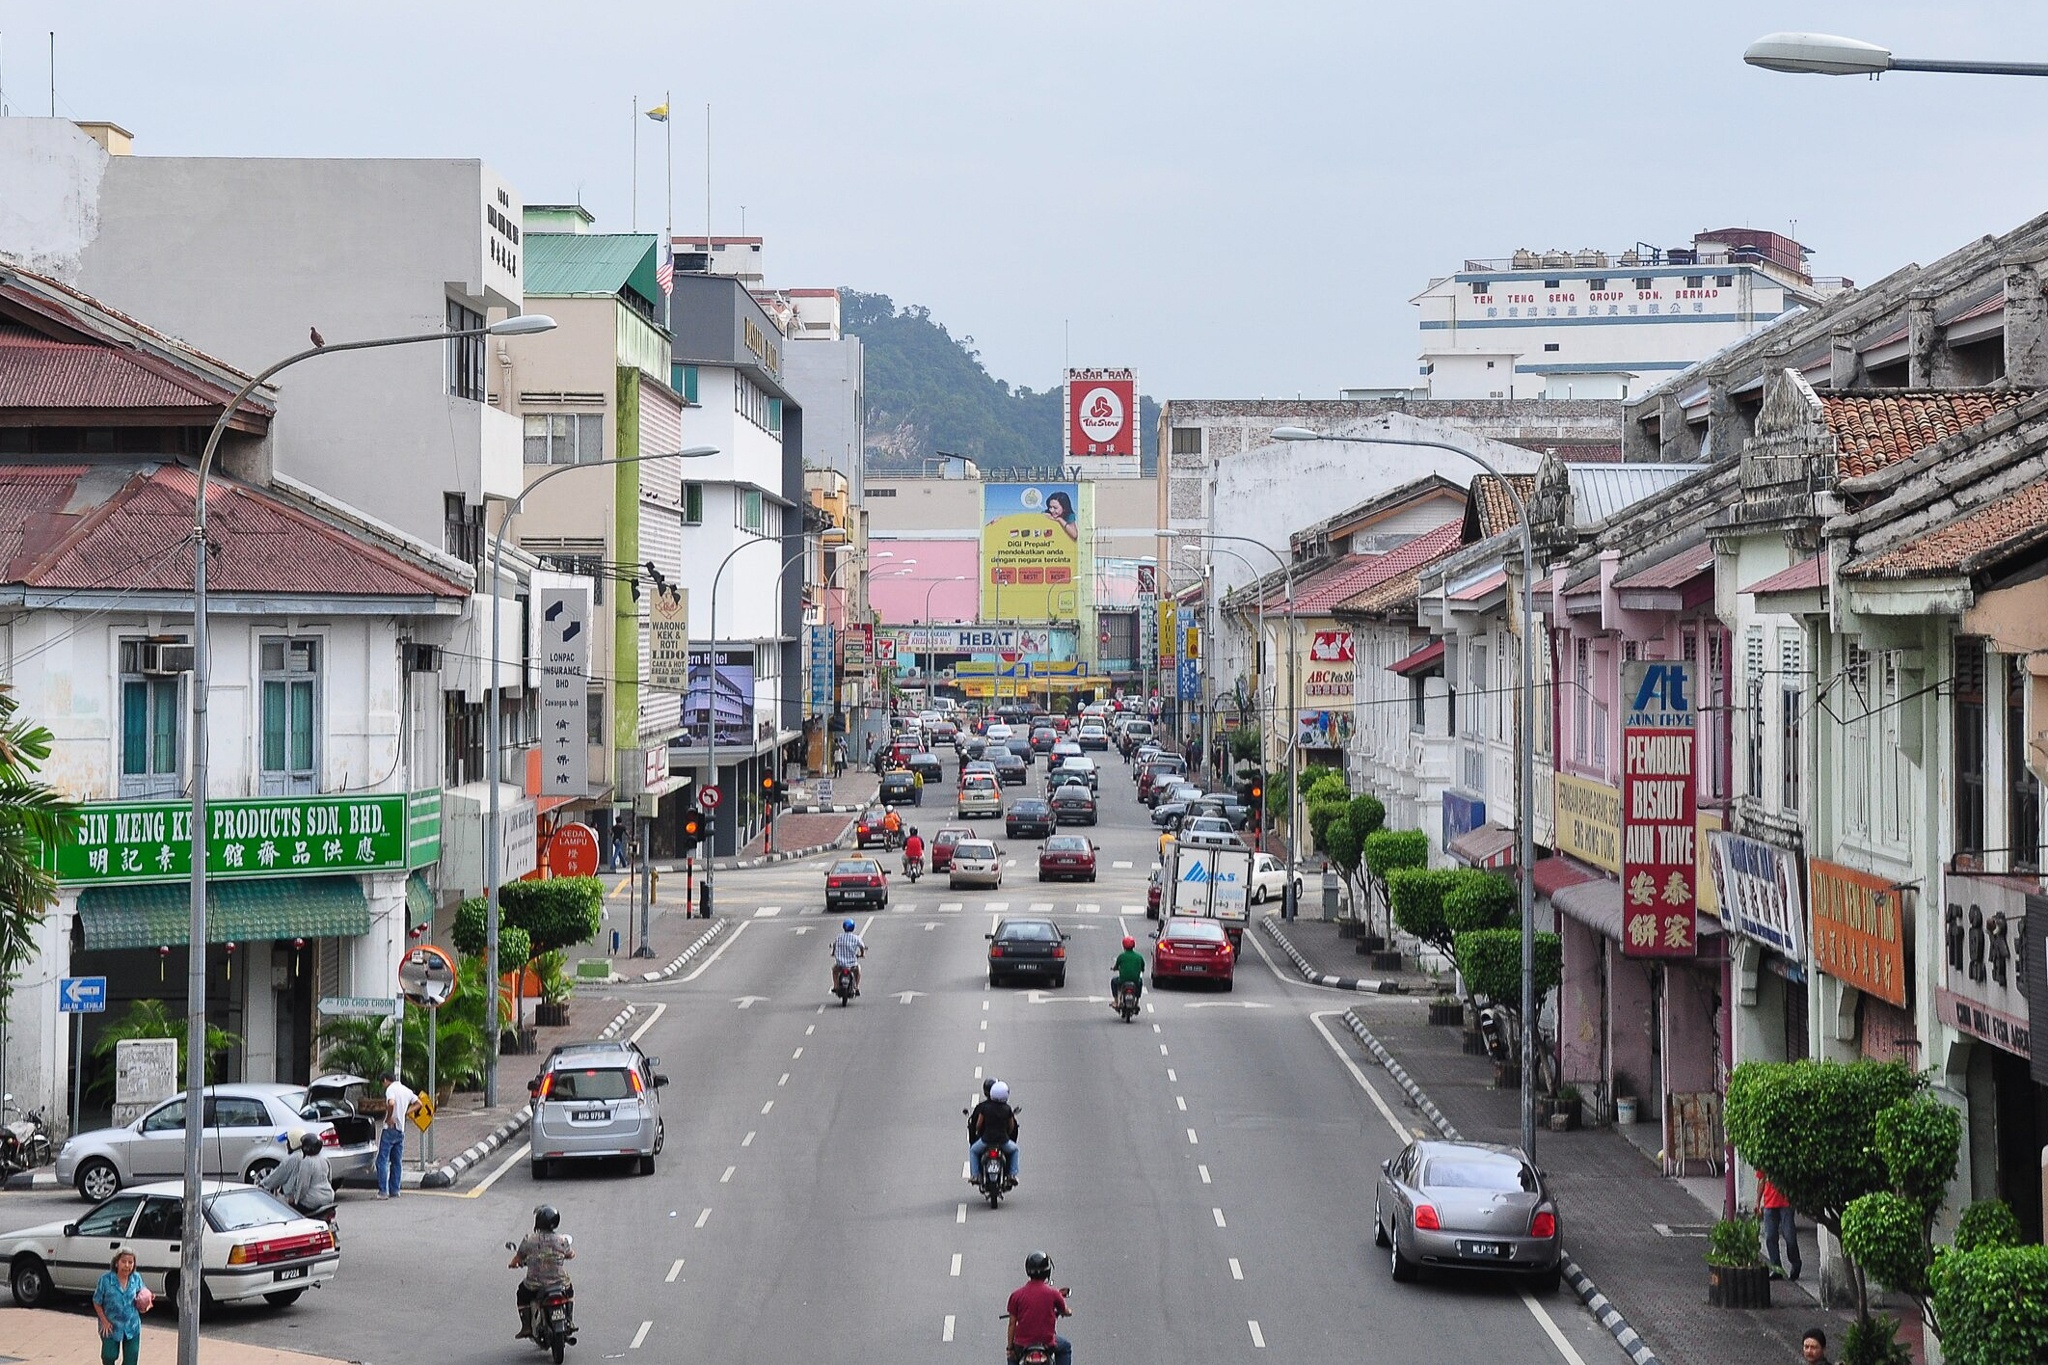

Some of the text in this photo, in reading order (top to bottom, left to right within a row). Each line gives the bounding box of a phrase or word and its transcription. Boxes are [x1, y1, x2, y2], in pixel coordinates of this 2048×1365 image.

[1474, 290, 1718, 304] TEH TENG SENG GROUP SDN. BERHAD
[1070, 371, 1133, 380] PASAR RAYA
[990, 465, 1081, 482] CATHAY
[652, 622, 686, 630] WARONG
[657, 631, 681, 640] KEK &
[660, 641, 678, 649] ROTI
[550, 653, 575, 662] LONPAC
[652, 650, 685, 659] LIDO
[704, 653, 728, 664] Htel
[544, 666, 581, 676] INSURANCE
[1308, 671, 1330, 683] ABC
[556, 679, 569, 688] BHD
[1627, 713, 1693, 726] AUN THYE
[1627, 735, 1692, 775] PEMBUAT
[1632, 780, 1685, 820] BISKUT
[79, 813, 109, 846] SIN
[115, 811, 165, 843] MENG
[213, 807, 300, 840] PRODUCTS
[307, 805, 342, 837] SDN.
[350, 804, 385, 834] BHD.
[1626, 825, 1693, 865] AUN THYE
[89, 836, 376, 875] 明記素館齋品供應
[1628, 870, 1692, 907] 安泰
[1628, 913, 1692, 948] 餅家
[351, 999, 368, 1008] CHOO
[371, 999, 393, 1008] CHOON
